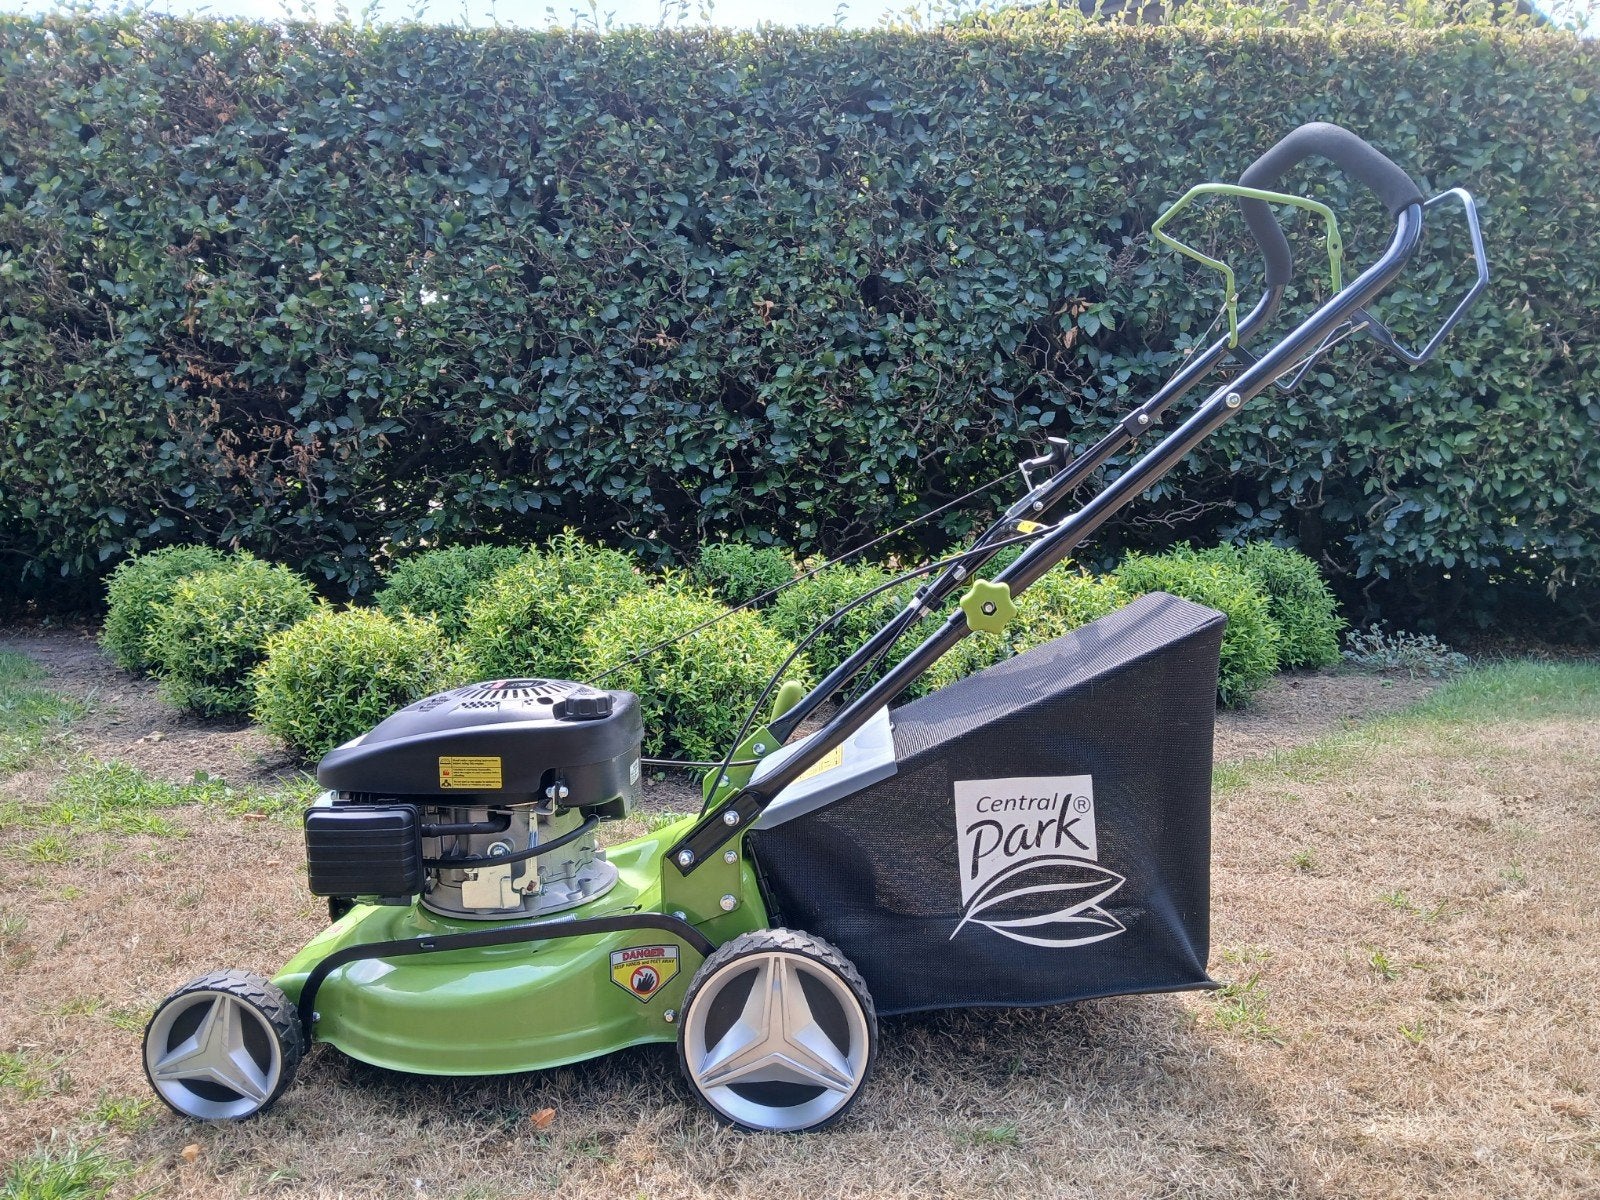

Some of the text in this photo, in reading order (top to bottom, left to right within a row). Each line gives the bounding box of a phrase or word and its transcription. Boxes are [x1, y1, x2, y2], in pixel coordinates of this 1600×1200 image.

[976, 792, 1058, 813] Central
[966, 793, 1090, 880] Park
[622, 947, 665, 961] DANGER
